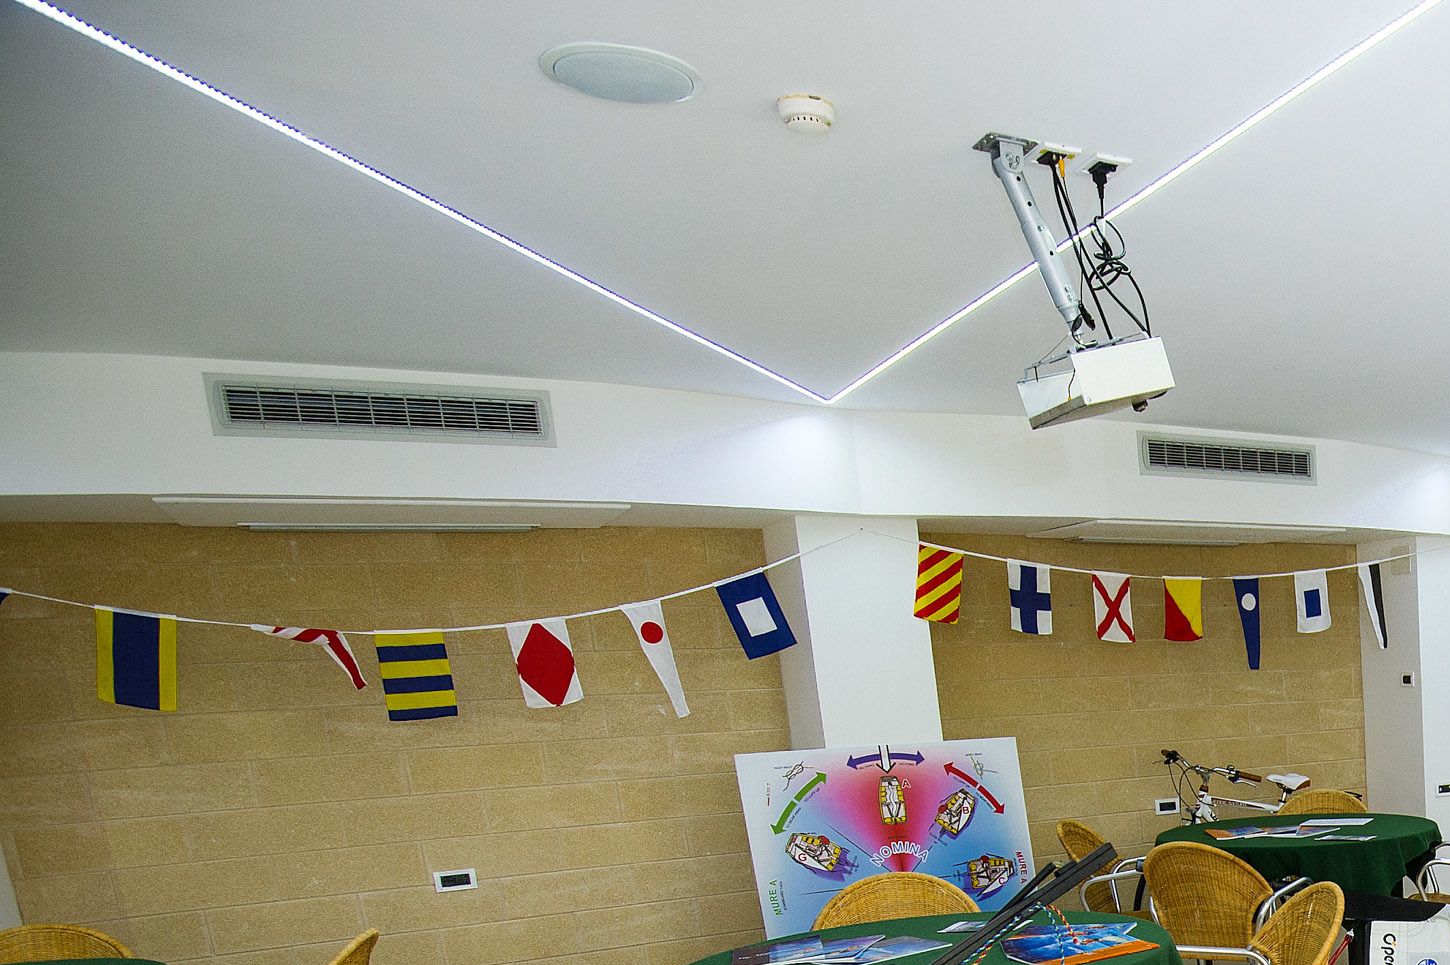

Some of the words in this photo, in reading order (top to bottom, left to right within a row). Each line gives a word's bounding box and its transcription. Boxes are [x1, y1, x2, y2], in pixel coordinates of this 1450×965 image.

[901, 778, 911, 788] A
[962, 806, 970, 814] B
[798, 853, 807, 861] G
[870, 841, 929, 866] NOMINA
[1016, 851, 1028, 875] MURE
[769, 889, 783, 916] MURE
